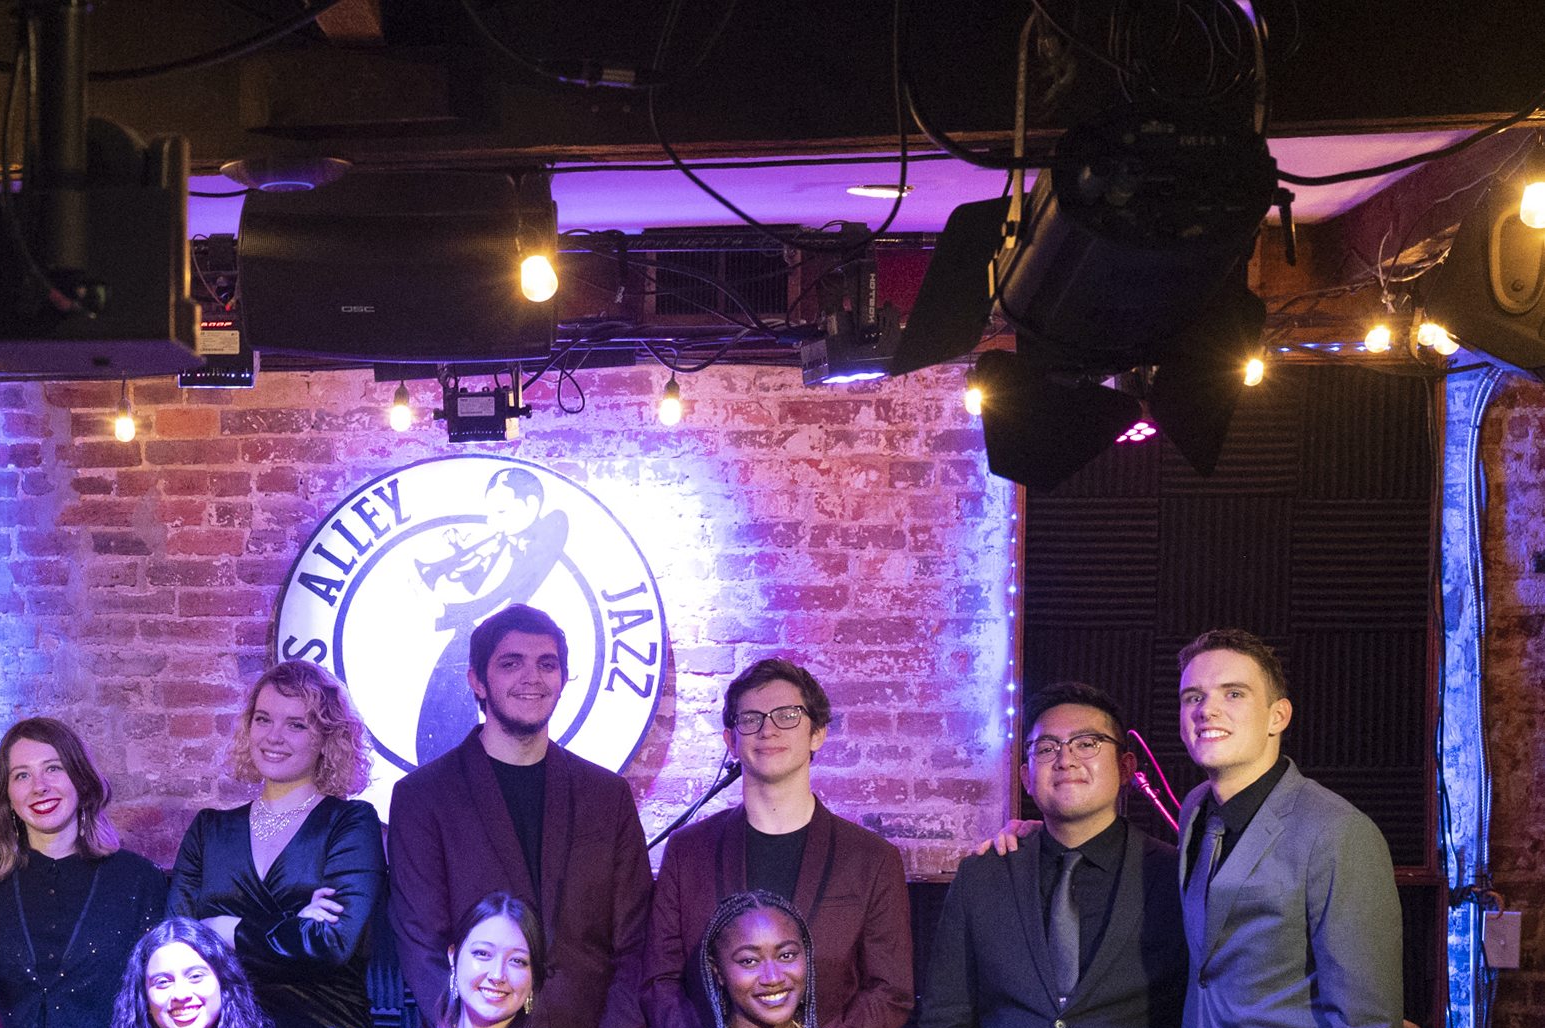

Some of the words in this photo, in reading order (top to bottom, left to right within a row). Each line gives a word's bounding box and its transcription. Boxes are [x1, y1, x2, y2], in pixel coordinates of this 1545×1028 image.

[341, 305, 375, 313] QSC
[298, 478, 412, 607] ALLEY
[601, 581, 658, 699] JAZZ
